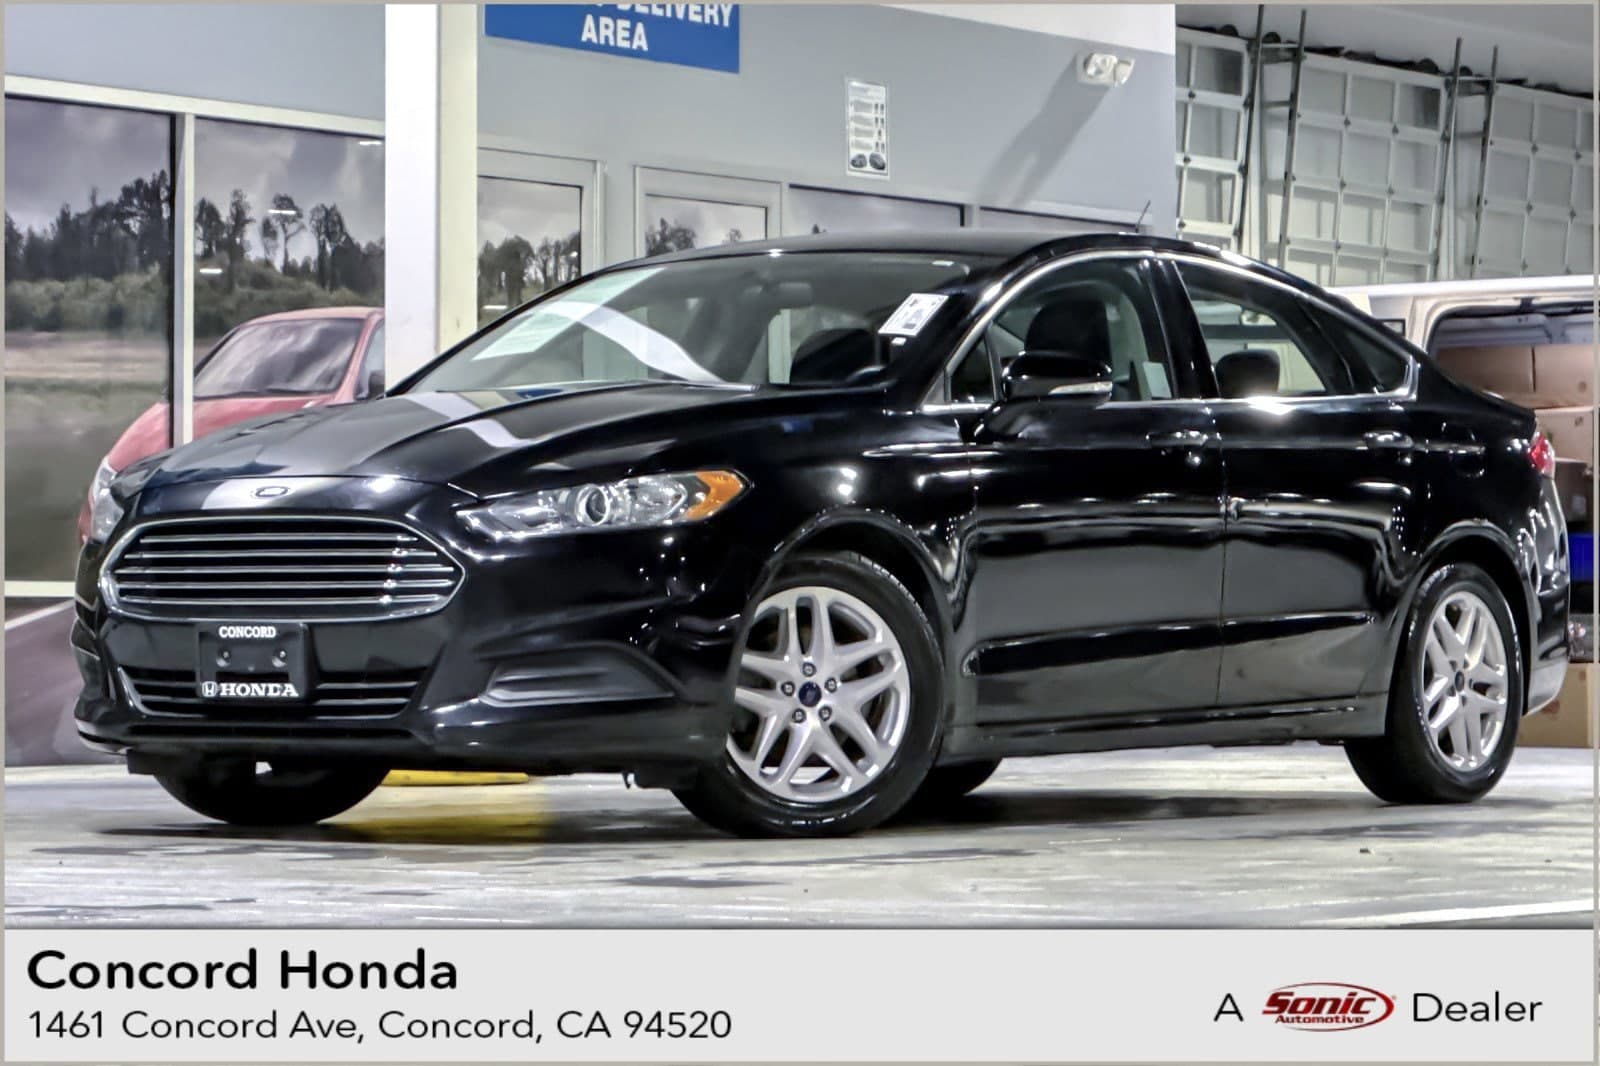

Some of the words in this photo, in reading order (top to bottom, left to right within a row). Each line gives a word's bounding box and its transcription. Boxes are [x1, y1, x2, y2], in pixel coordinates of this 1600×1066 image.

[616, 4, 734, 27] VERY
[580, 13, 649, 51] AREA
[218, 625, 277, 639] CONCORD
[219, 682, 299, 698] HONDA
